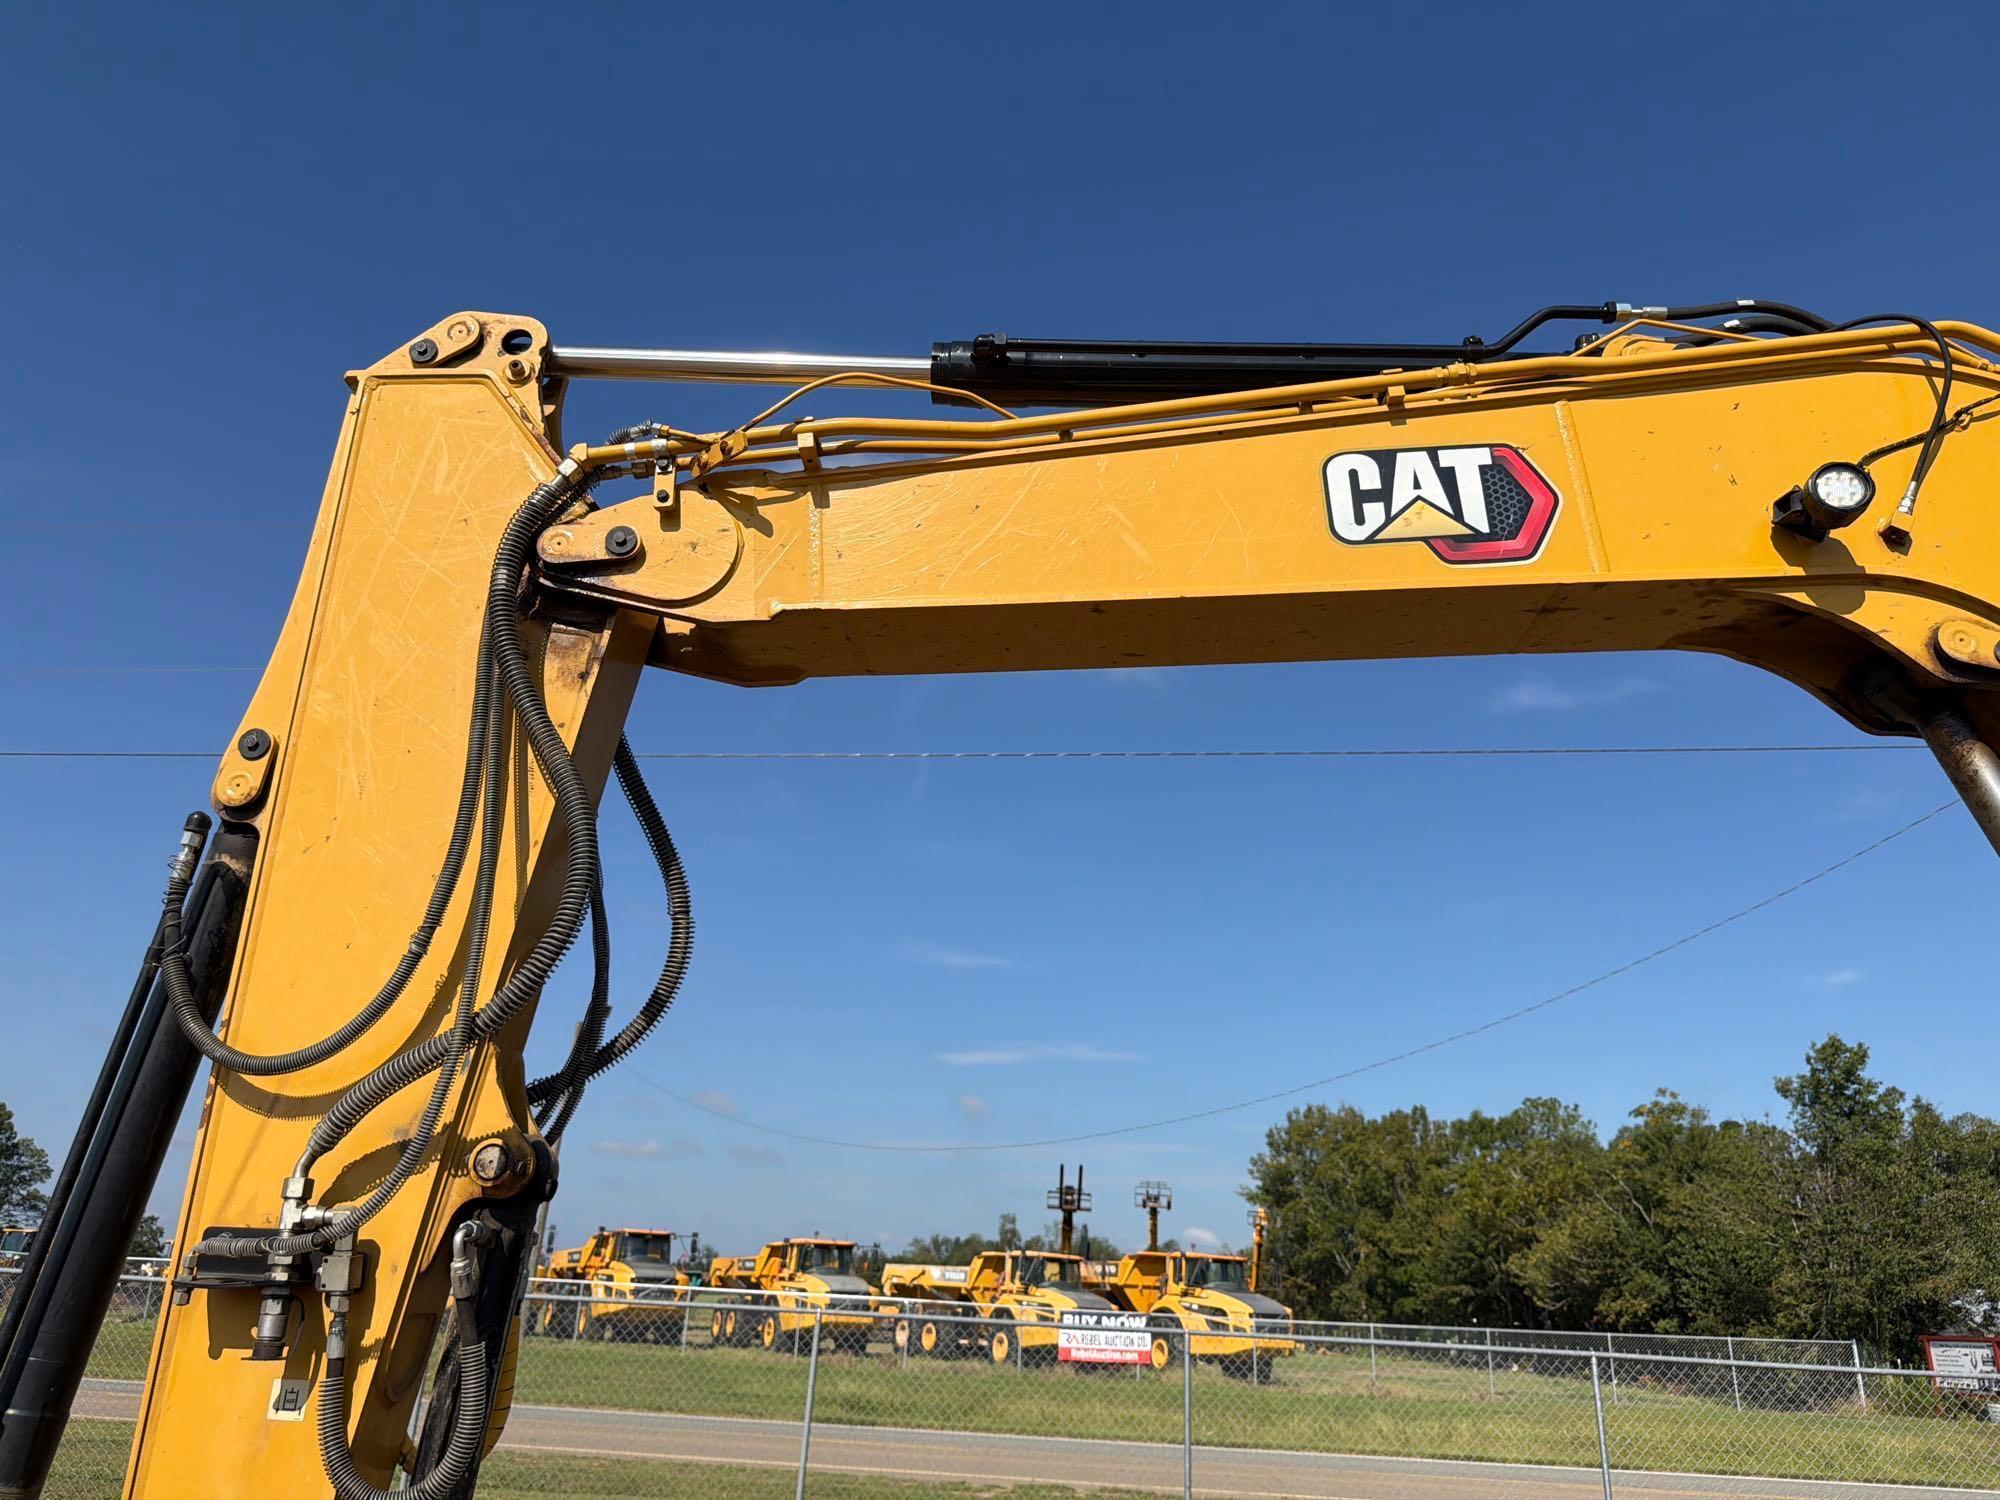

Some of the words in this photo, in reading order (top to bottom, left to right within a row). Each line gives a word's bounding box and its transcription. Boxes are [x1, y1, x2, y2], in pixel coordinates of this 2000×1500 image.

[1326, 447, 1493, 541] CAT
[1062, 1313, 1098, 1325] BUY
[1101, 1315, 1147, 1328] NOW
